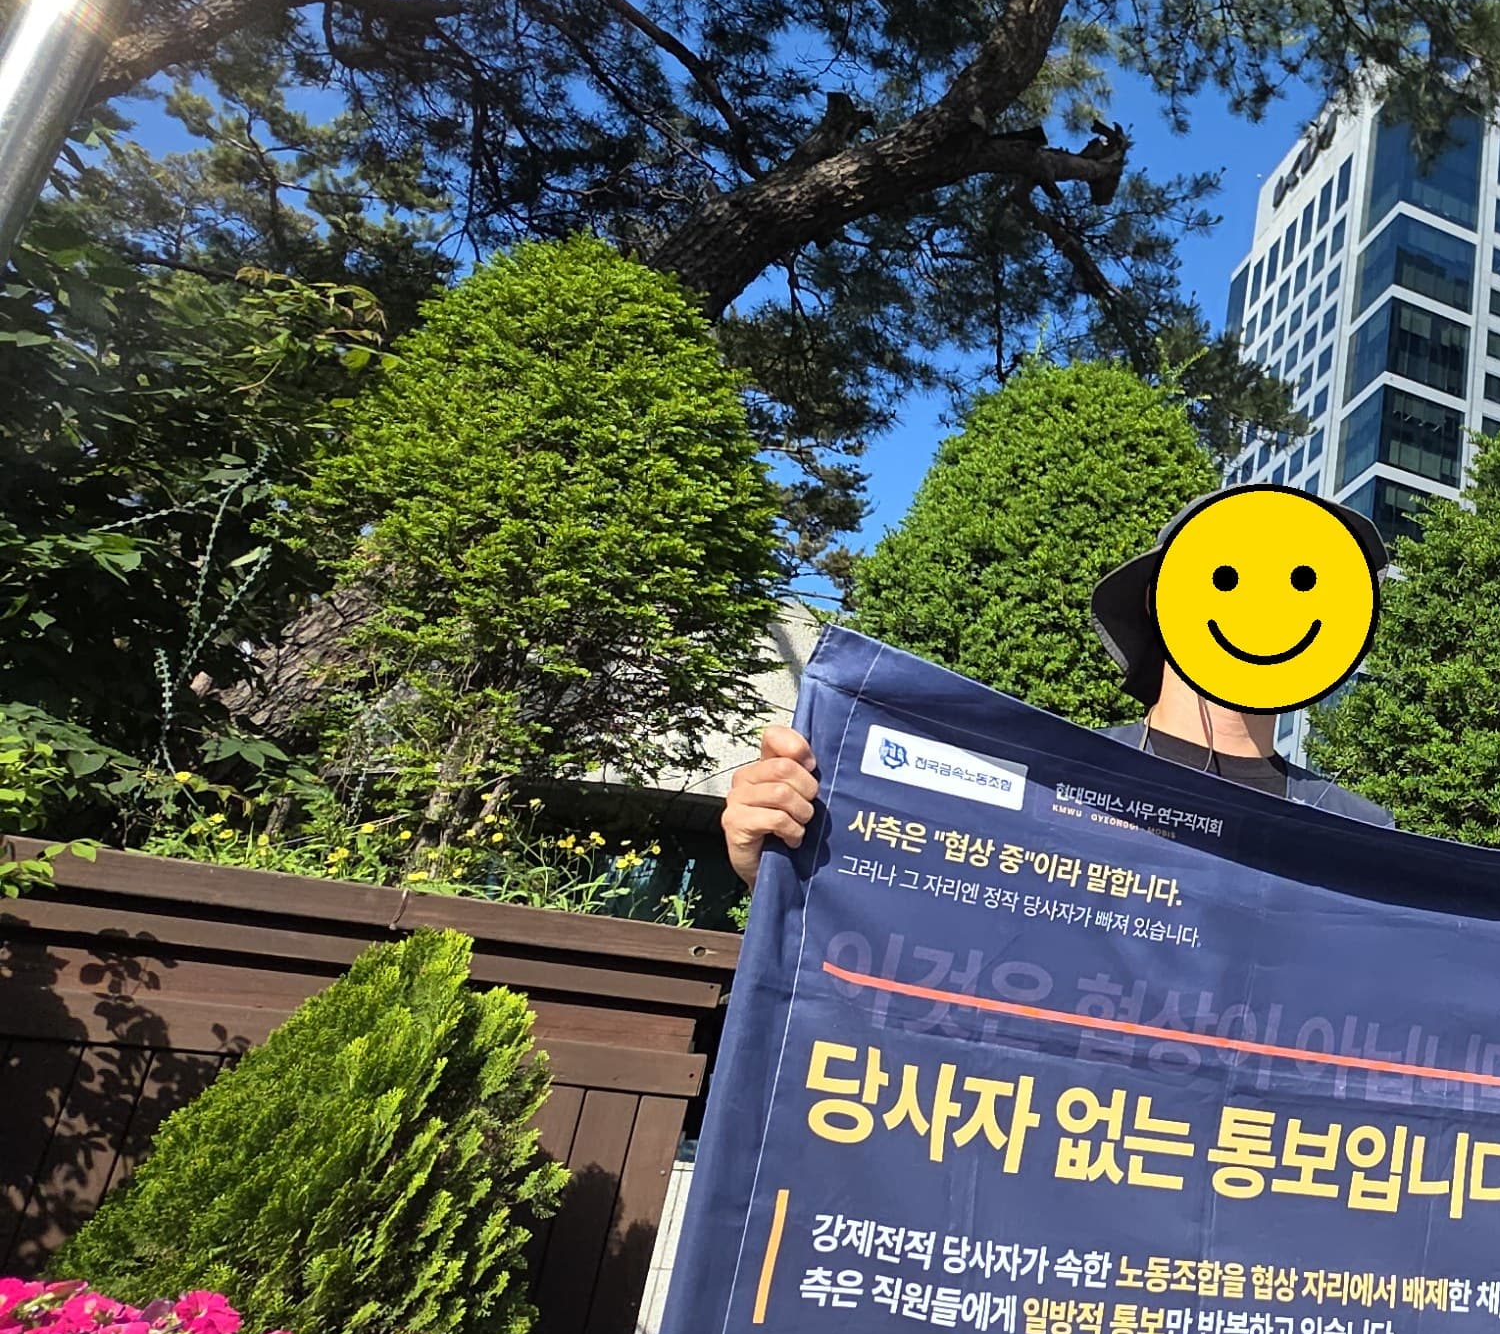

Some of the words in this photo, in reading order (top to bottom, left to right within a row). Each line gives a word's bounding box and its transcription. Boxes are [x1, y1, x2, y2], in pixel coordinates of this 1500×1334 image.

[1052, 803, 1082, 818] KMWU
[1147, 826, 1177, 839] MOBIS
[1056, 782, 1124, 812] 현대모비스
[837, 854, 897, 885] 그러나
[899, 869, 919, 890] 그
[923, 873, 979, 905] 자리엔
[983, 887, 1019, 914] 정작
[1023, 895, 1092, 929] 당사자가
[1094, 910, 1128, 935] 빠져
[1133, 916, 1202, 948] 있습니다.
[848, 810, 927, 853] 사측은
[933, 829, 995, 868] "협상
[998, 846, 1082, 889] 중"이라
[1086, 864, 1182, 907] 말합니다.
[825, 930, 1053, 1050] 이것은
[1074, 972, 1283, 1090] 협상이
[804, 1039, 1041, 1174] 당사자
[1054, 1084, 1197, 1190] 없는
[799, 1266, 864, 1308] 측은
[872, 1274, 1017, 1334] 직원들에게
[812, 1213, 936, 1271] 강제전적
[943, 1235, 1049, 1285] 당사자가
[1054, 1249, 1112, 1288] 속한
[1115, 1255, 1246, 1299] 노동조합을
[1251, 1265, 1298, 1302] 협상
[1301, 1270, 1397, 1309] 자리에서
[1402, 1276, 1471, 1313] 배제한
